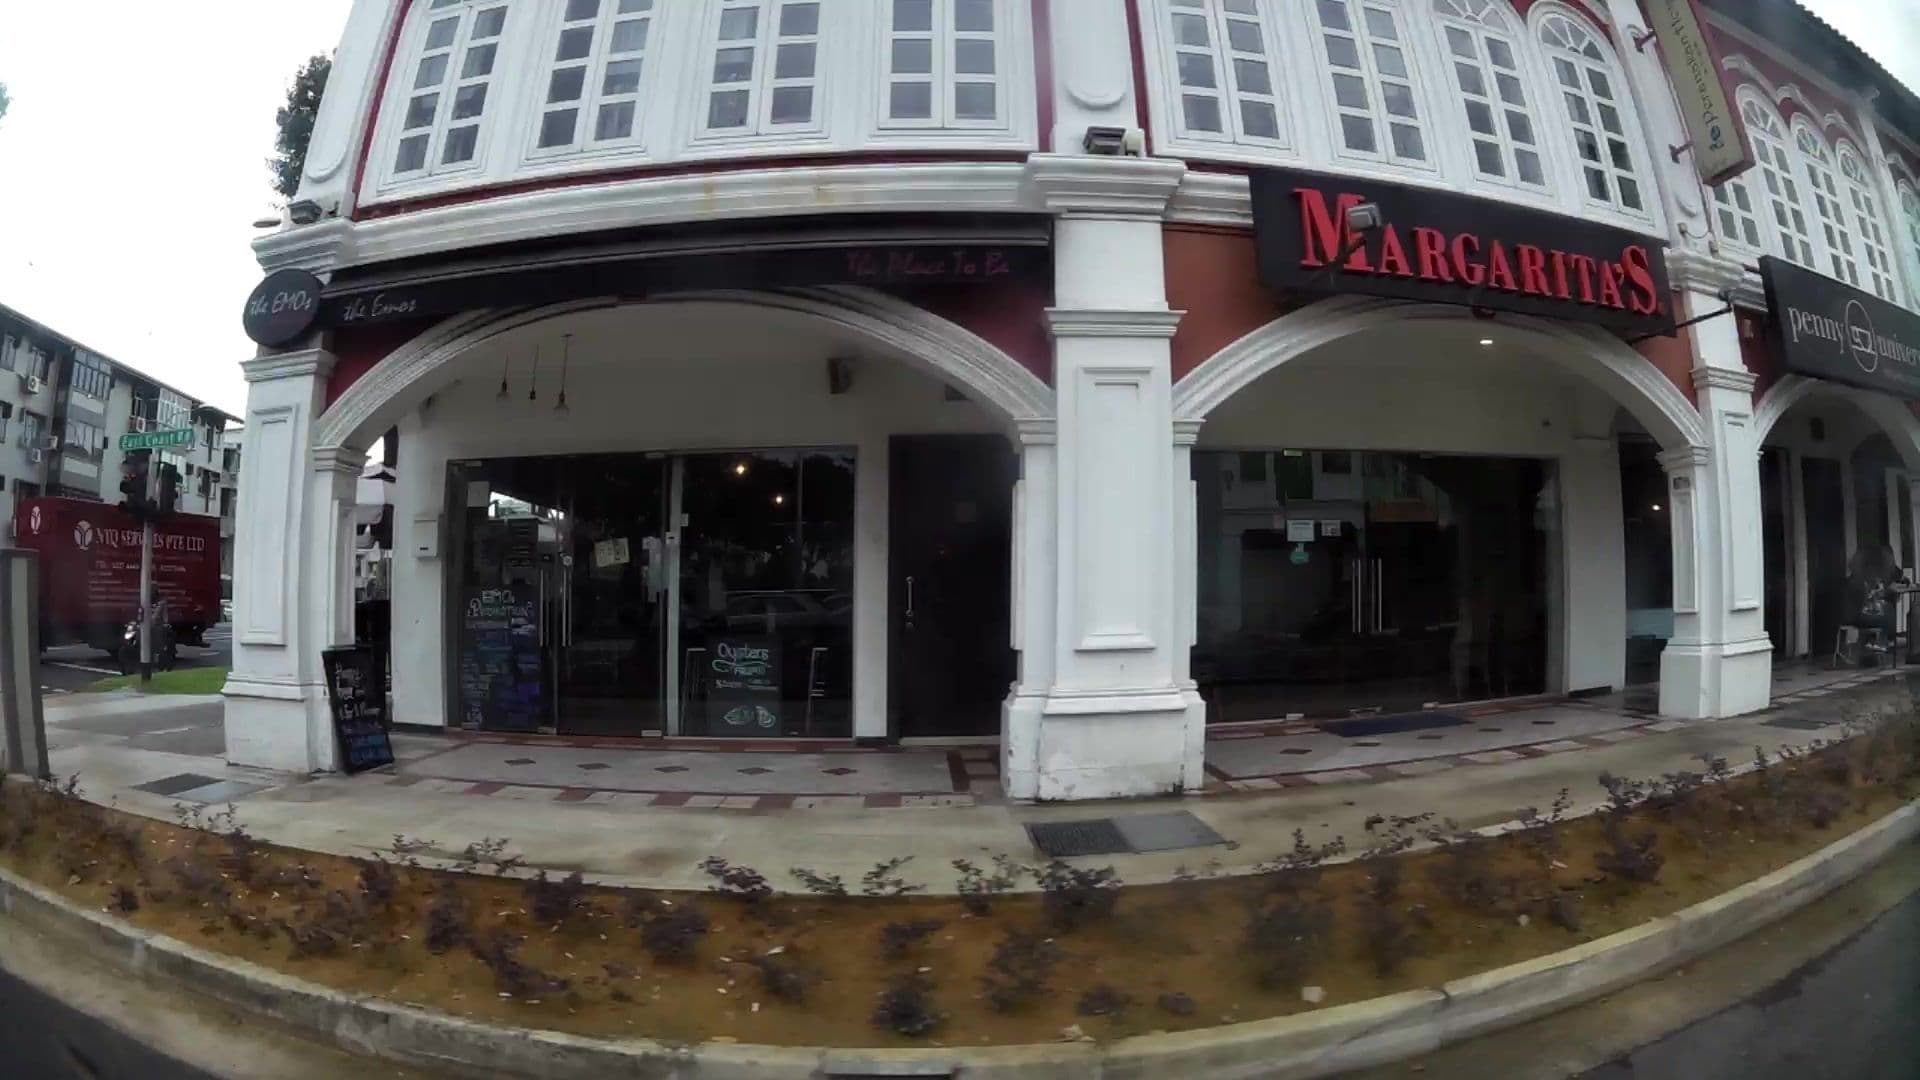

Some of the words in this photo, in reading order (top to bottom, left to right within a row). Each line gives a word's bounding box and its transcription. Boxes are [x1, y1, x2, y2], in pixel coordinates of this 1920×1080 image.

[1788, 307, 1844, 354] penny
[121, 434, 144, 449] East
[145, 432, 174, 447] Coast
[121, 529, 164, 549] SERVES
[166, 533, 184, 551] PTE
[186, 536, 205, 552] LTD
